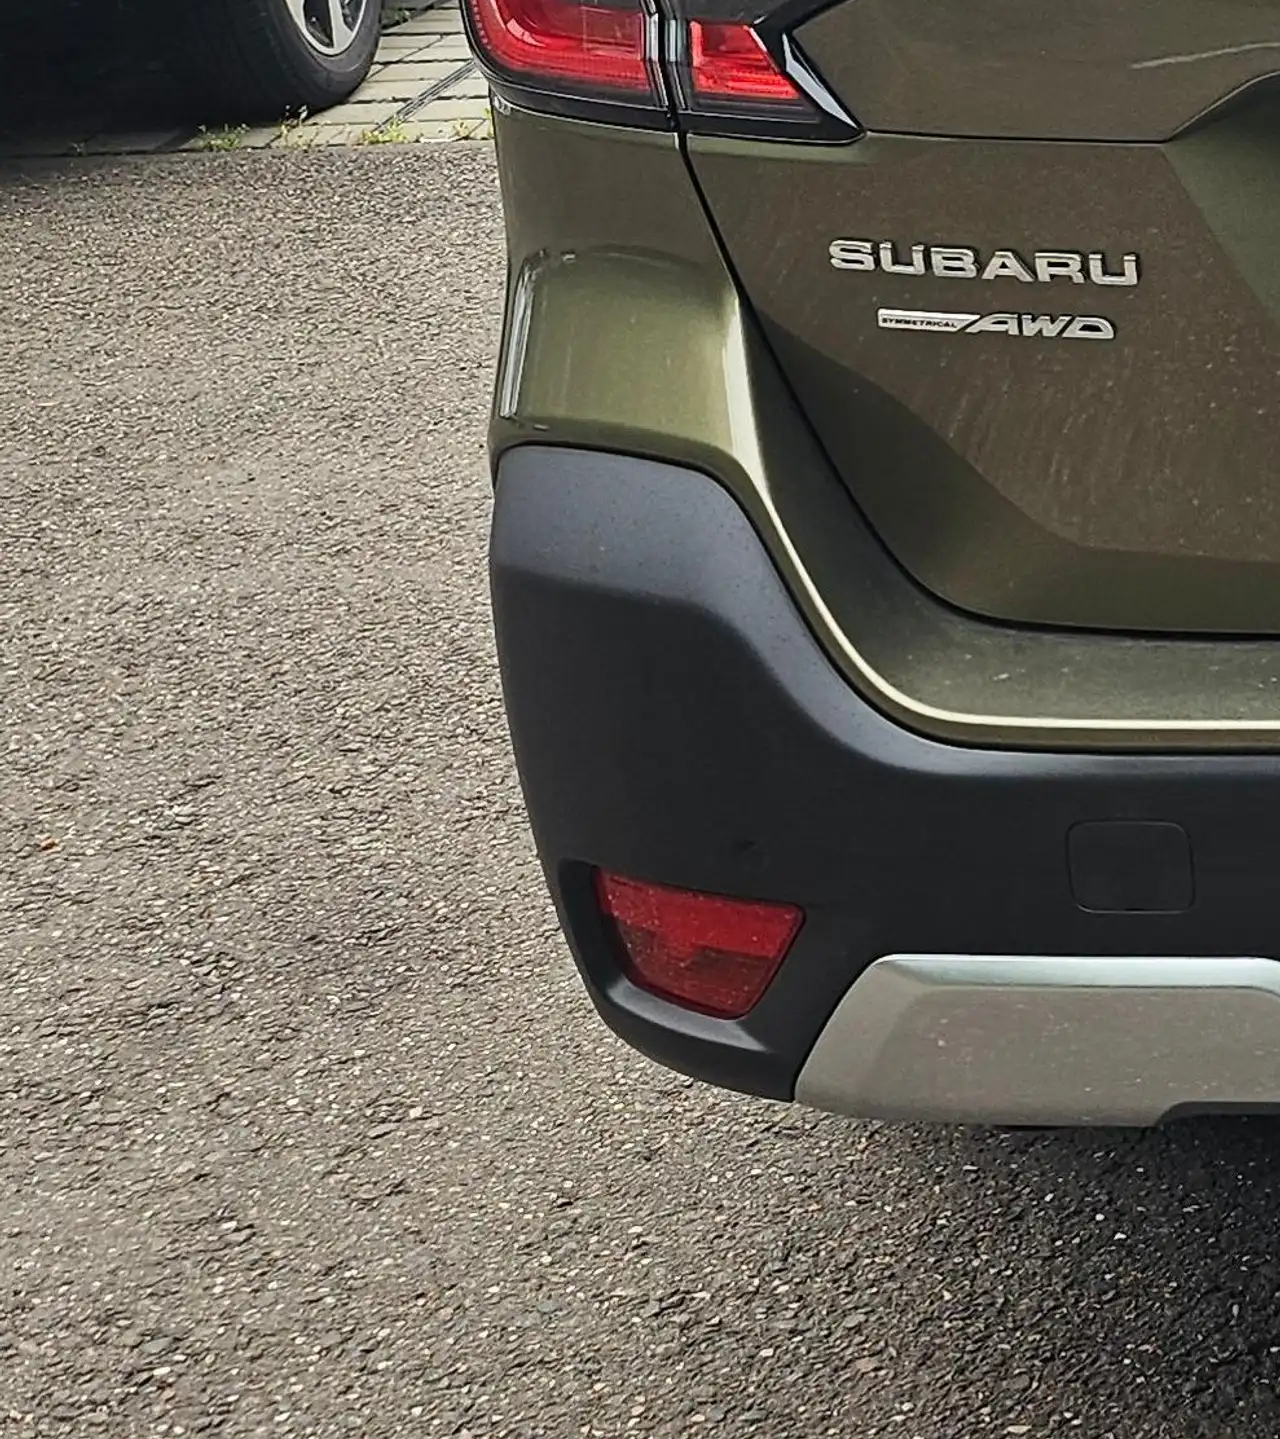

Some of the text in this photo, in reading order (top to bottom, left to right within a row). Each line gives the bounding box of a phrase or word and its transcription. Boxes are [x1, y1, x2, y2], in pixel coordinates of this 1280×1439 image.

[828, 239, 1139, 286] SUBARU
[881, 313, 1115, 340] SYMMETRICAL AWD
